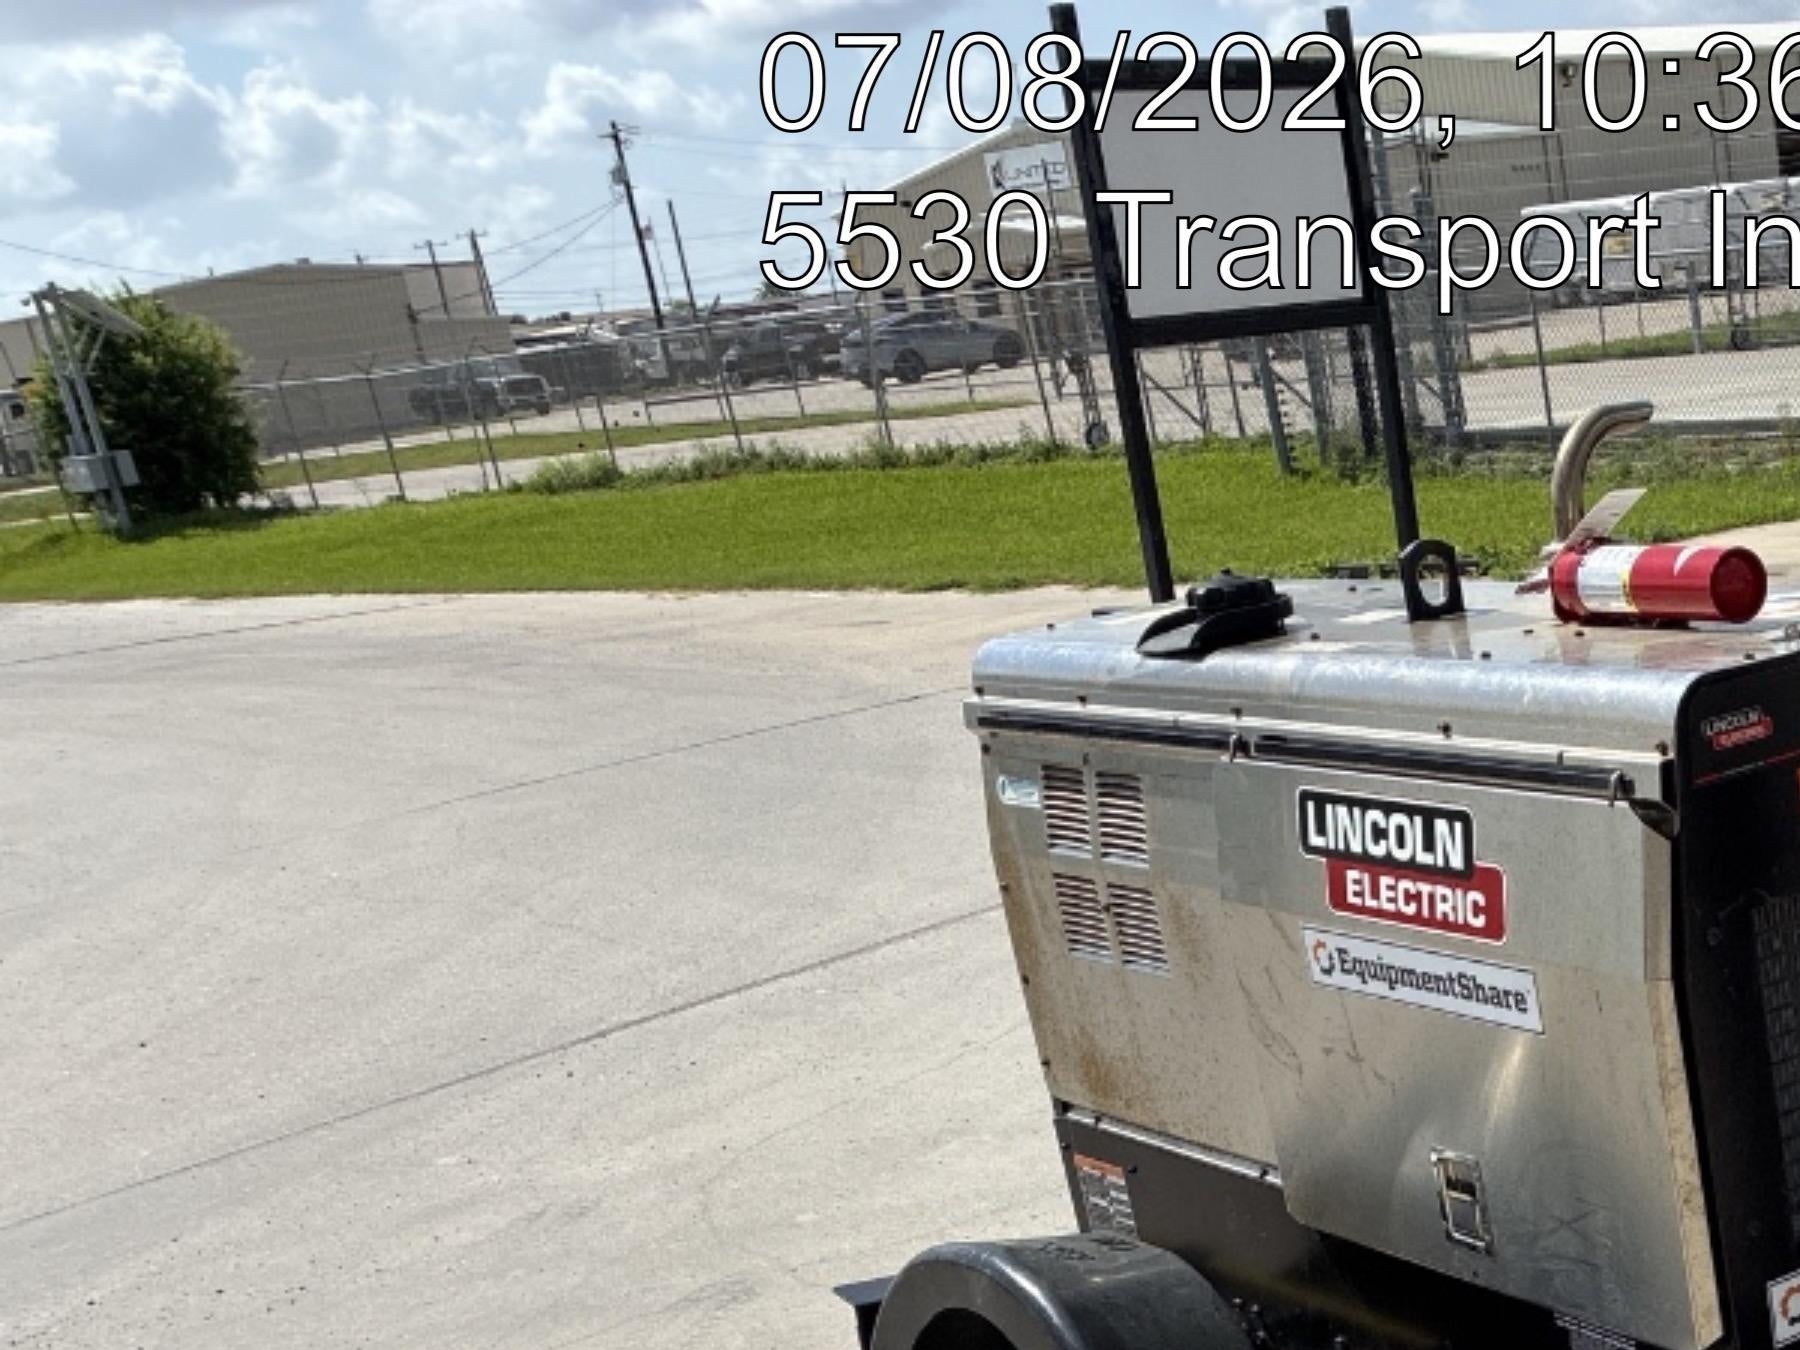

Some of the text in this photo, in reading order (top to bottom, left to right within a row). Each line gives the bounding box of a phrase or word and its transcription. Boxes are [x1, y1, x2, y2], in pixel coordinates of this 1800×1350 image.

[1306, 799, 1465, 872] LINCOLN
[1345, 869, 1487, 929] ELECTRIC
[1335, 947, 1529, 1014] EquipmentShare
